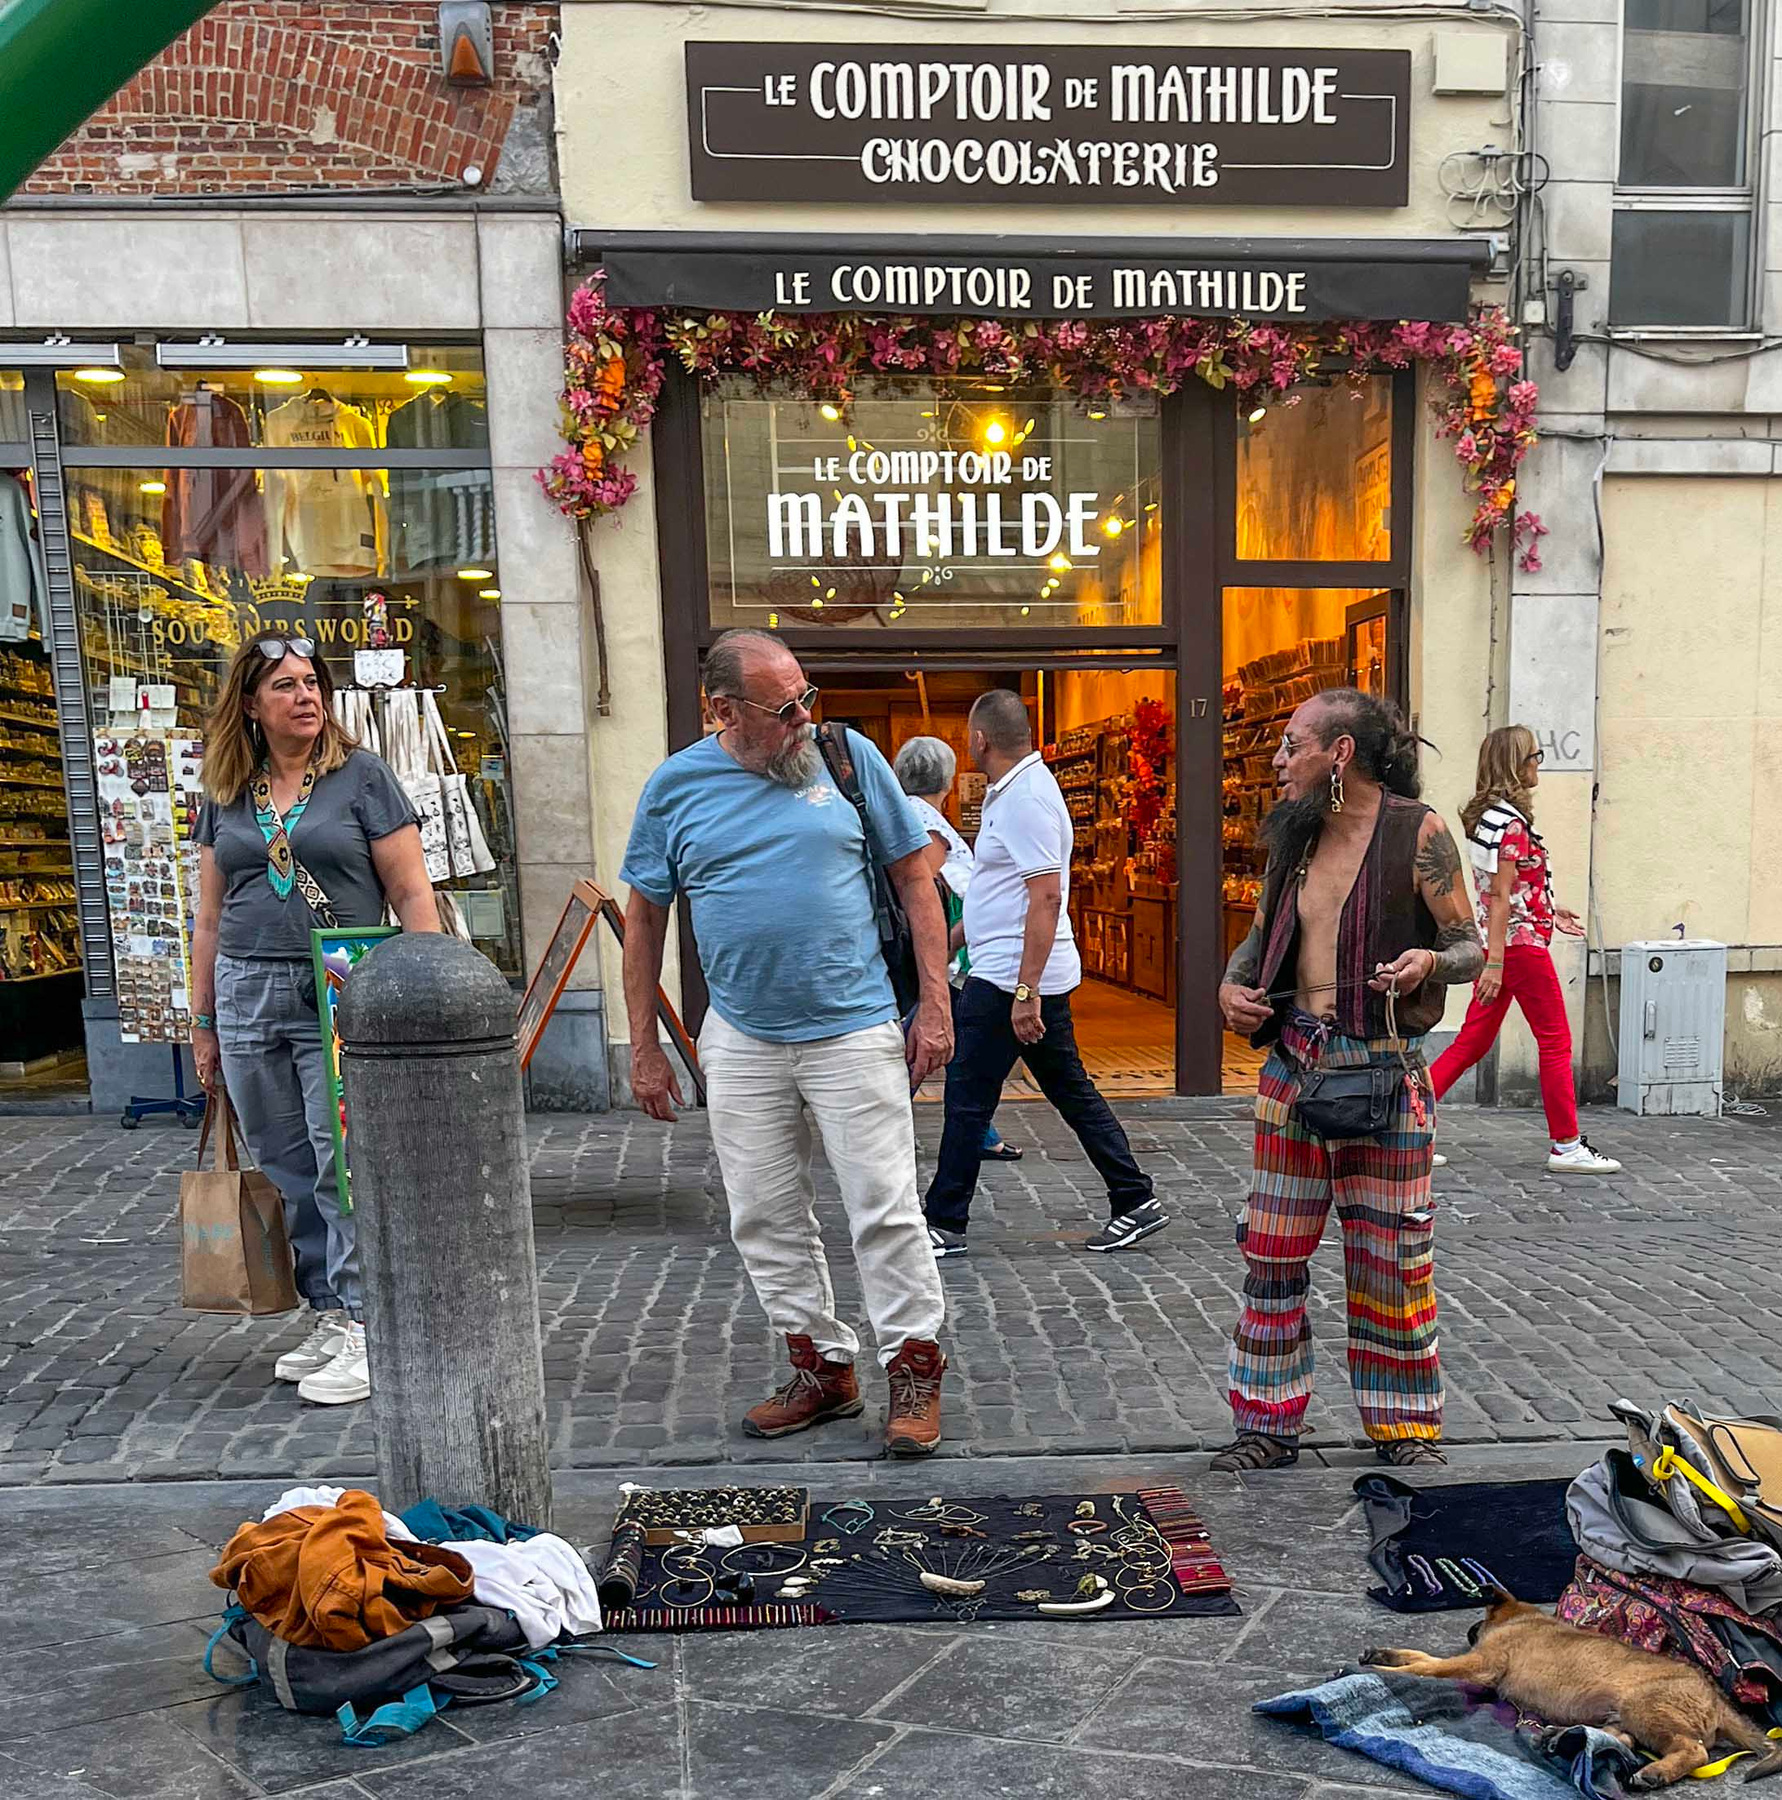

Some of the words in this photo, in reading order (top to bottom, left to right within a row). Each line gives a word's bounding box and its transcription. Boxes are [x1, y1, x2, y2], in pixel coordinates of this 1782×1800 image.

[765, 75, 796, 106] LE
[810, 62, 1051, 121] COMPTOIR
[1065, 78, 1098, 108] DE
[1111, 64, 1338, 124] MATHILDE
[860, 138, 1218, 194] CHOCOLATERIE
[775, 271, 811, 305] LE
[831, 265, 1031, 309] COMPTOIR
[1053, 275, 1094, 309] DE
[1113, 269, 1306, 312] MATHILDE
[290, 430, 344, 442] BELGIUM
[814, 456, 841, 482] LE
[848, 450, 1012, 485] COMPTOIR
[1022, 456, 1052, 482] DE
[767, 491, 1101, 558] MATHILDE
[152, 619, 307, 644] SOUENIRS
[315, 618, 413, 643] WORD
[1191, 698, 1207, 717] 17
